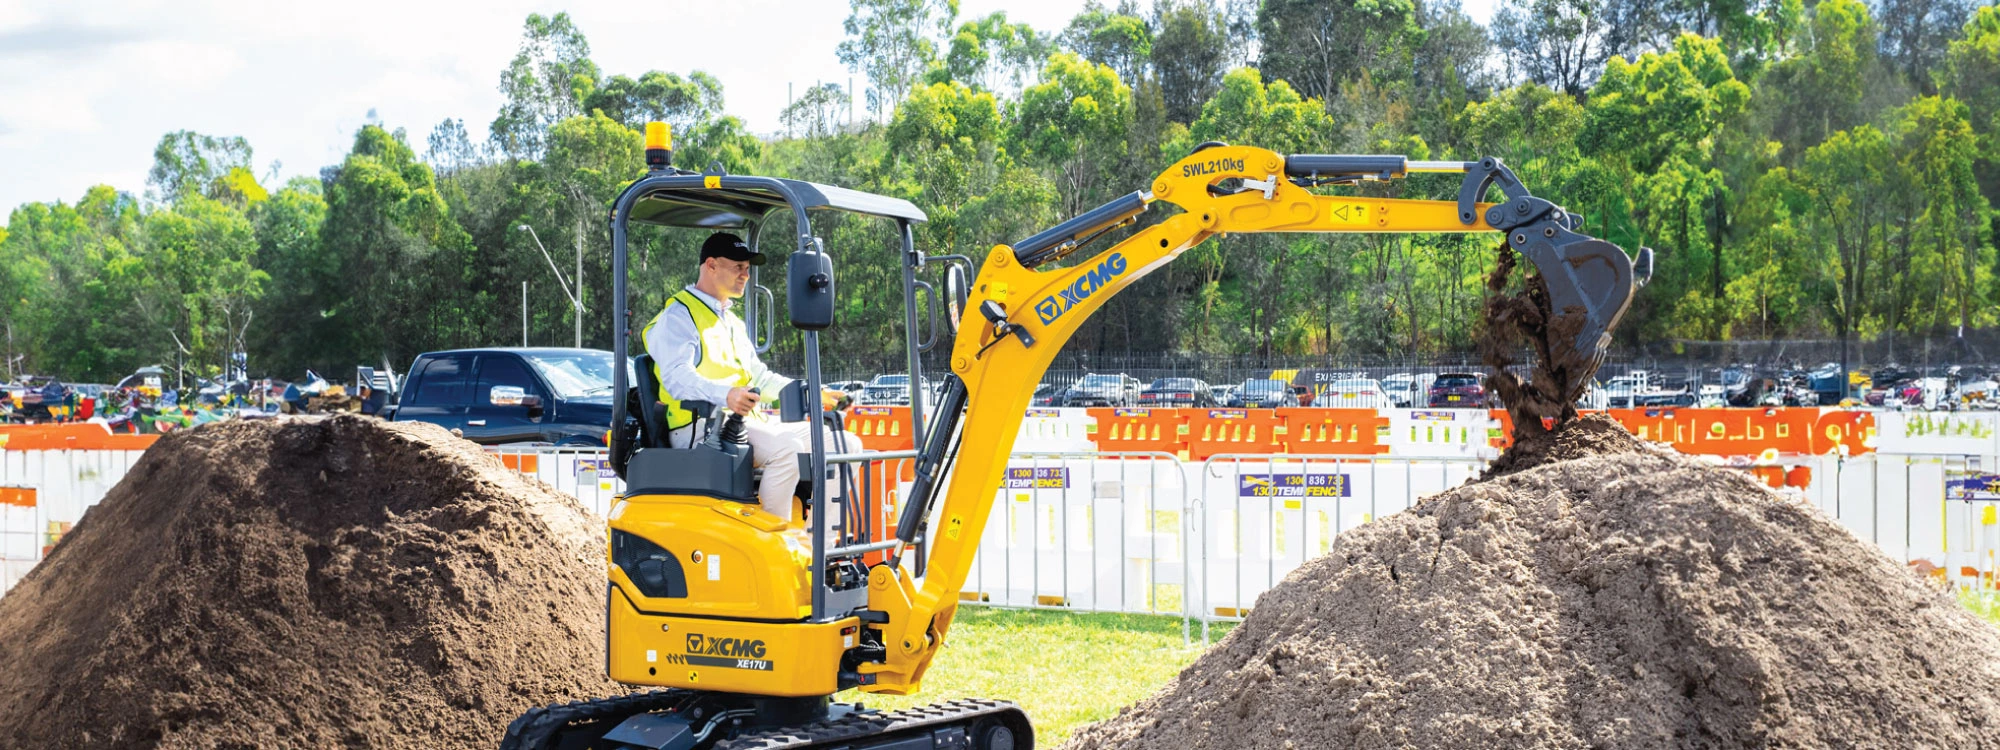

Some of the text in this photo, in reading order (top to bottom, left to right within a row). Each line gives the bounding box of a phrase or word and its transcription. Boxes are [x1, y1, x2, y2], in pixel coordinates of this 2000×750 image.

[1183, 158, 1245, 178] SWL210kg
[1058, 252, 1127, 313] XCMG
[1013, 469, 1032, 477] 1300
[1037, 469, 1048, 477] 36
[1309, 476, 1325, 485] 836
[704, 637, 766, 658] XCMG
[736, 659, 767, 670] XE17U
